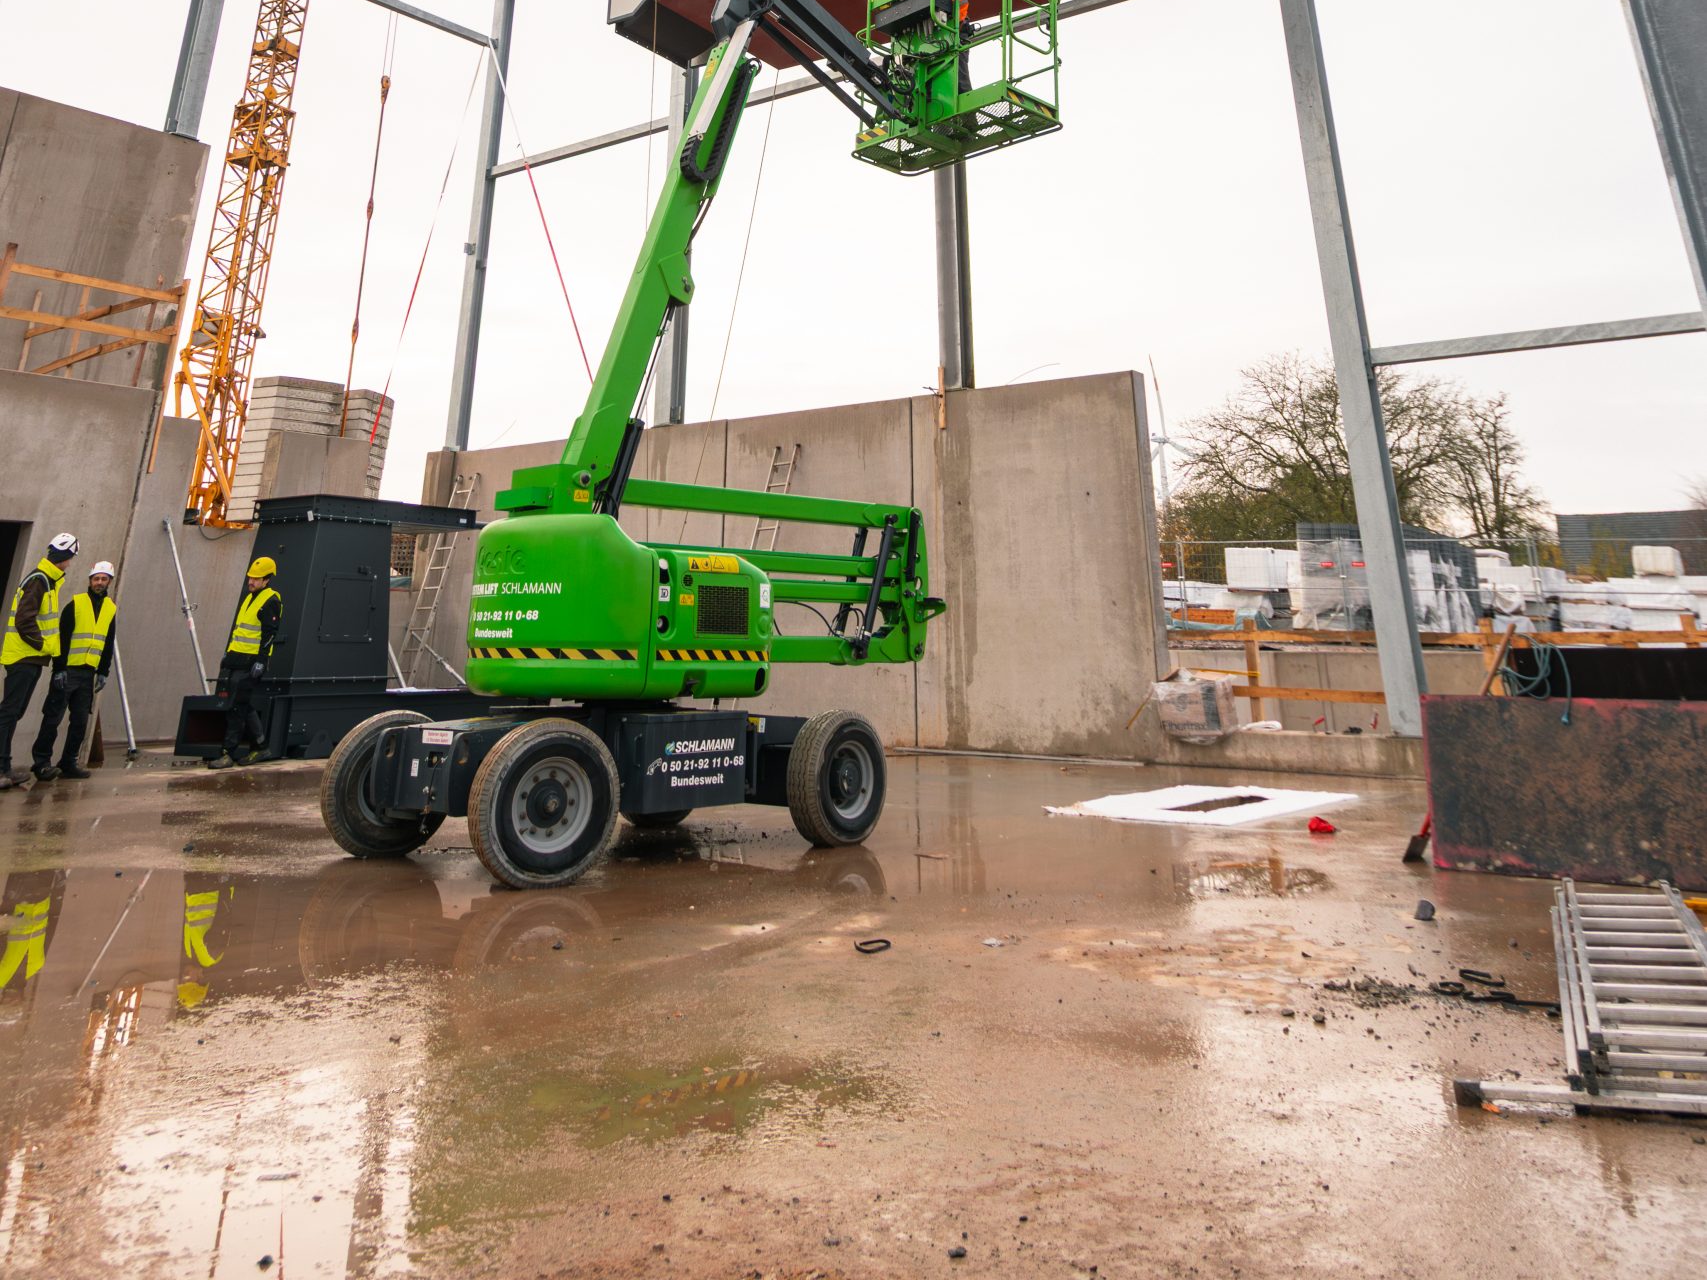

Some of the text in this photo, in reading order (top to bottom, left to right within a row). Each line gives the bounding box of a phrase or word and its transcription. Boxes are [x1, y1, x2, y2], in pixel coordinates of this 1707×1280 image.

[501, 582, 562, 595] SCHLAMANN
[504, 610, 513, 621] 11
[474, 628, 513, 638] Bundesweit
[675, 738, 735, 753] SCHLAMANN
[661, 761, 668, 773] 0
[669, 760, 682, 772] 50
[712, 757, 721, 768] 11
[671, 773, 724, 787] Bundesweit
